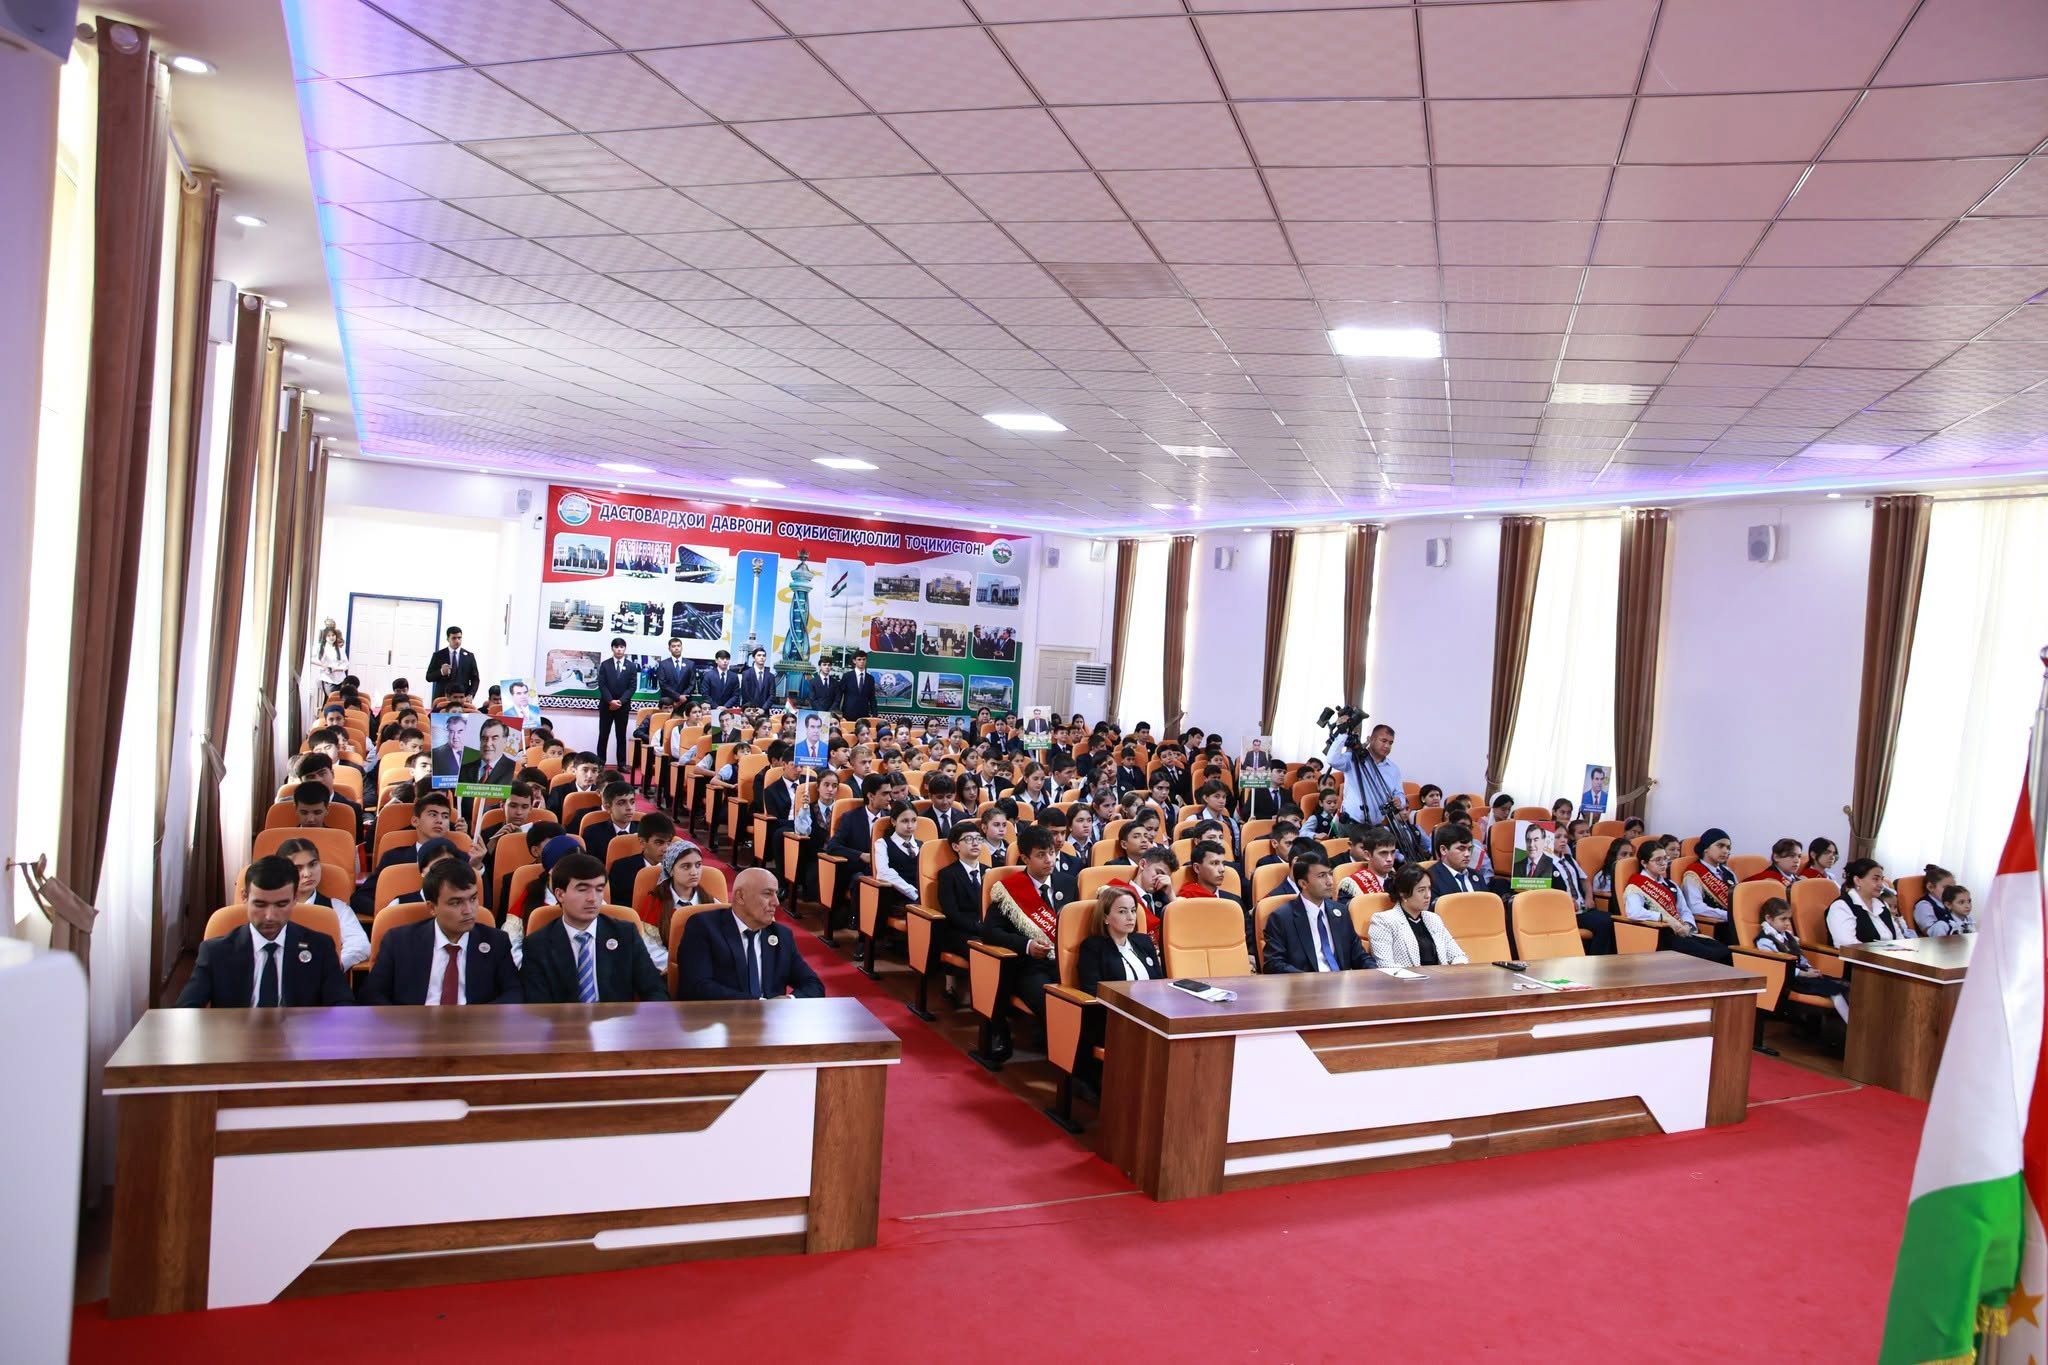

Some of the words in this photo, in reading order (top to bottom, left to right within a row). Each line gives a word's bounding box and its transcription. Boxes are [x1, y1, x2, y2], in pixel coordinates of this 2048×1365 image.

[600, 504, 706, 528] ДАСТОВАРДҲОИ
[711, 516, 773, 534] ДАВРОНИ
[778, 523, 901, 547] СОҲИБИСТИҚЛОЛИИ
[906, 536, 984, 556] ТОҶИКИСТОН!
